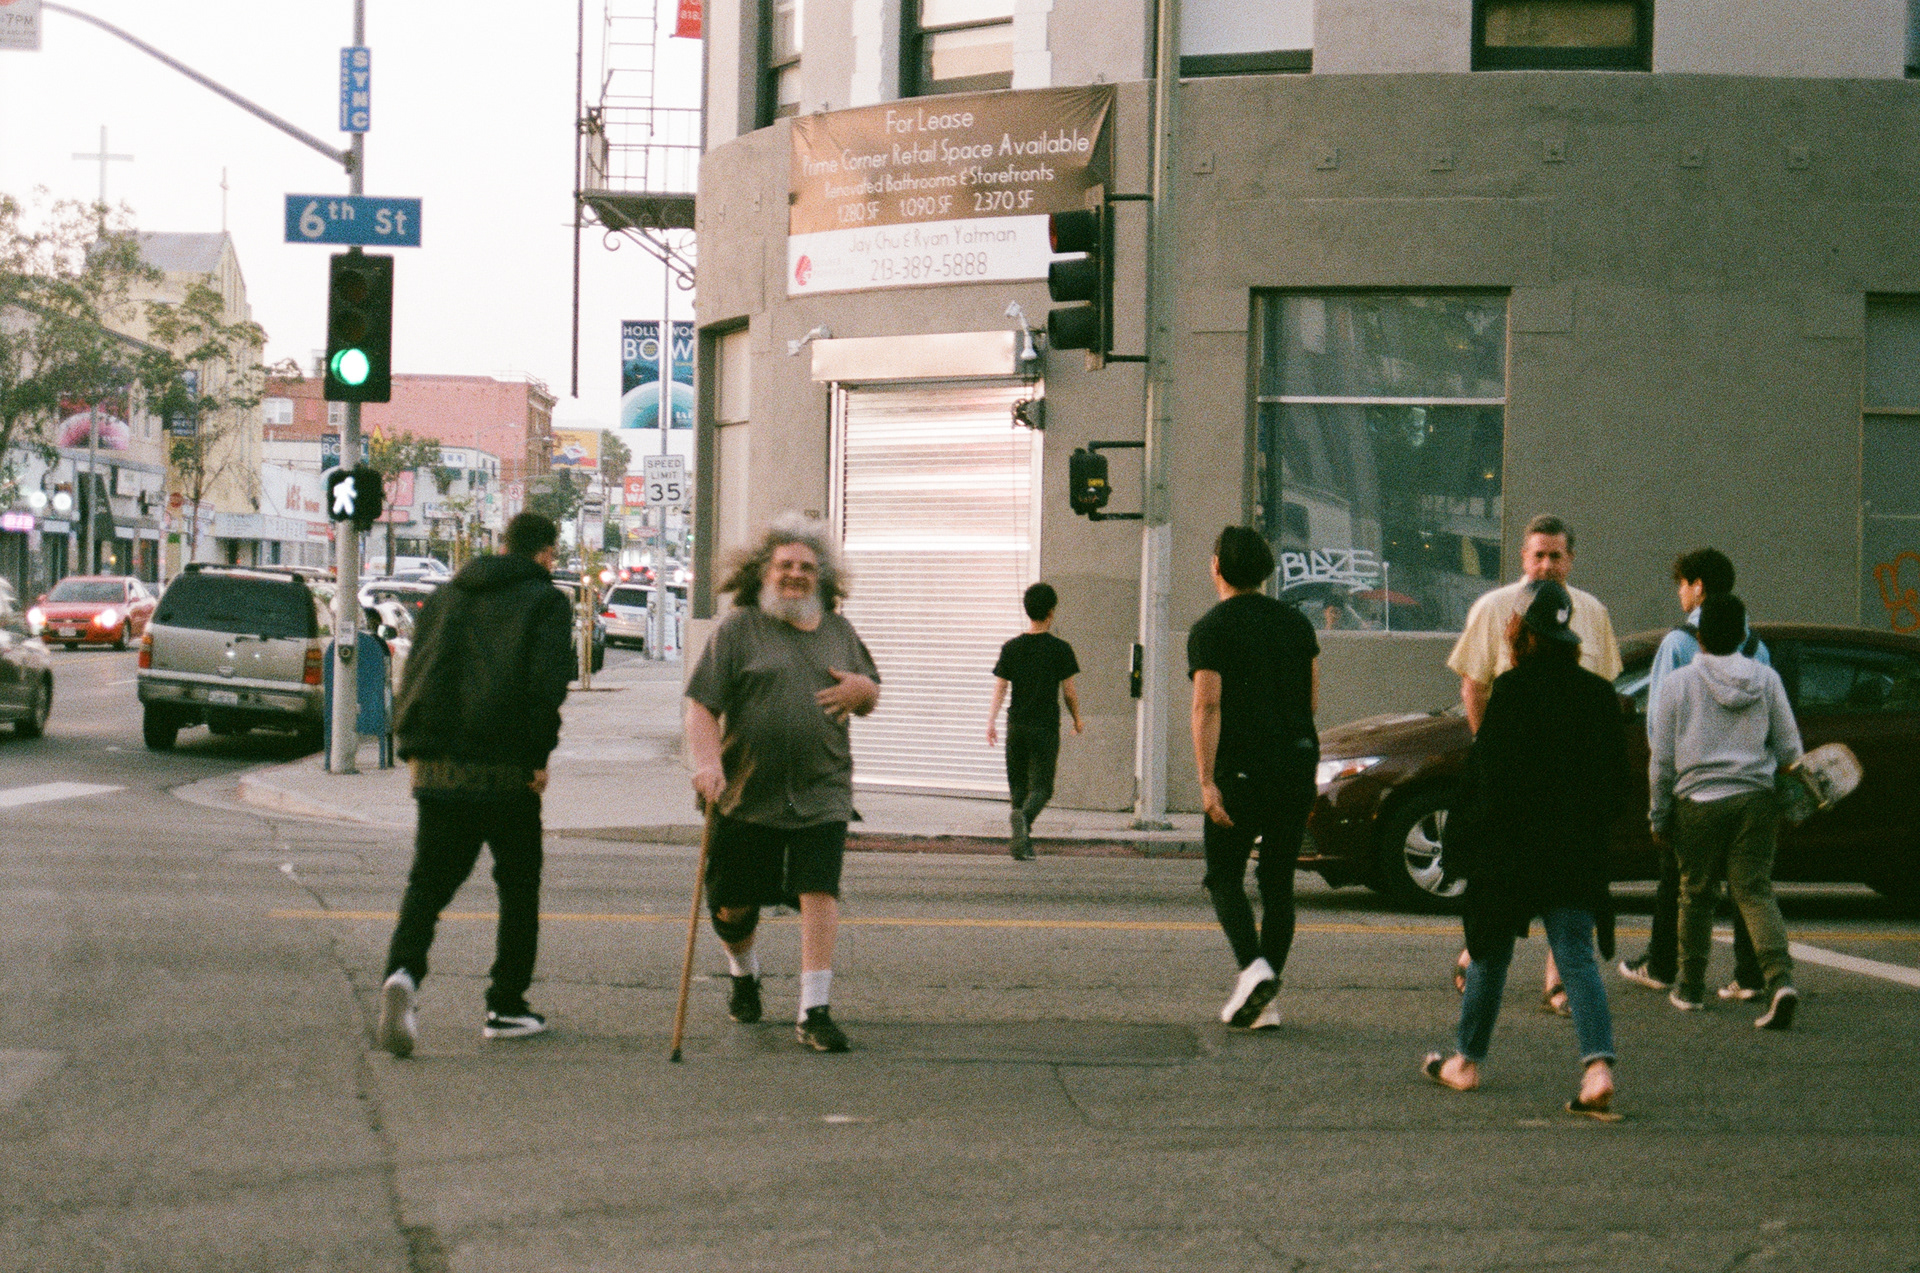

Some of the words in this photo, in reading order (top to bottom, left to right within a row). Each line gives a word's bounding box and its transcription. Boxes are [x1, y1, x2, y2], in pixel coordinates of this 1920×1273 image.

[886, 110, 913, 134] For
[917, 109, 974, 132] Lease
[802, 155, 838, 177] Prime
[841, 149, 888, 172] Corner
[893, 142, 936, 164] Retail
[941, 139, 993, 164] Space
[999, 130, 1090, 156] Available
[887, 172, 957, 194] Bathrooms
[969, 163, 1055, 185] Storefronts
[867, 201, 880, 221] SF
[937, 195, 952, 215] SF
[1018, 189, 1034, 209] SF
[299, 201, 355, 238] 6th
[374, 208, 408, 235] St
[913, 227, 949, 250] Ryan
[647, 460, 681, 469] SPEED
[651, 472, 677, 480] LIMIT
[651, 483, 680, 502] 35
